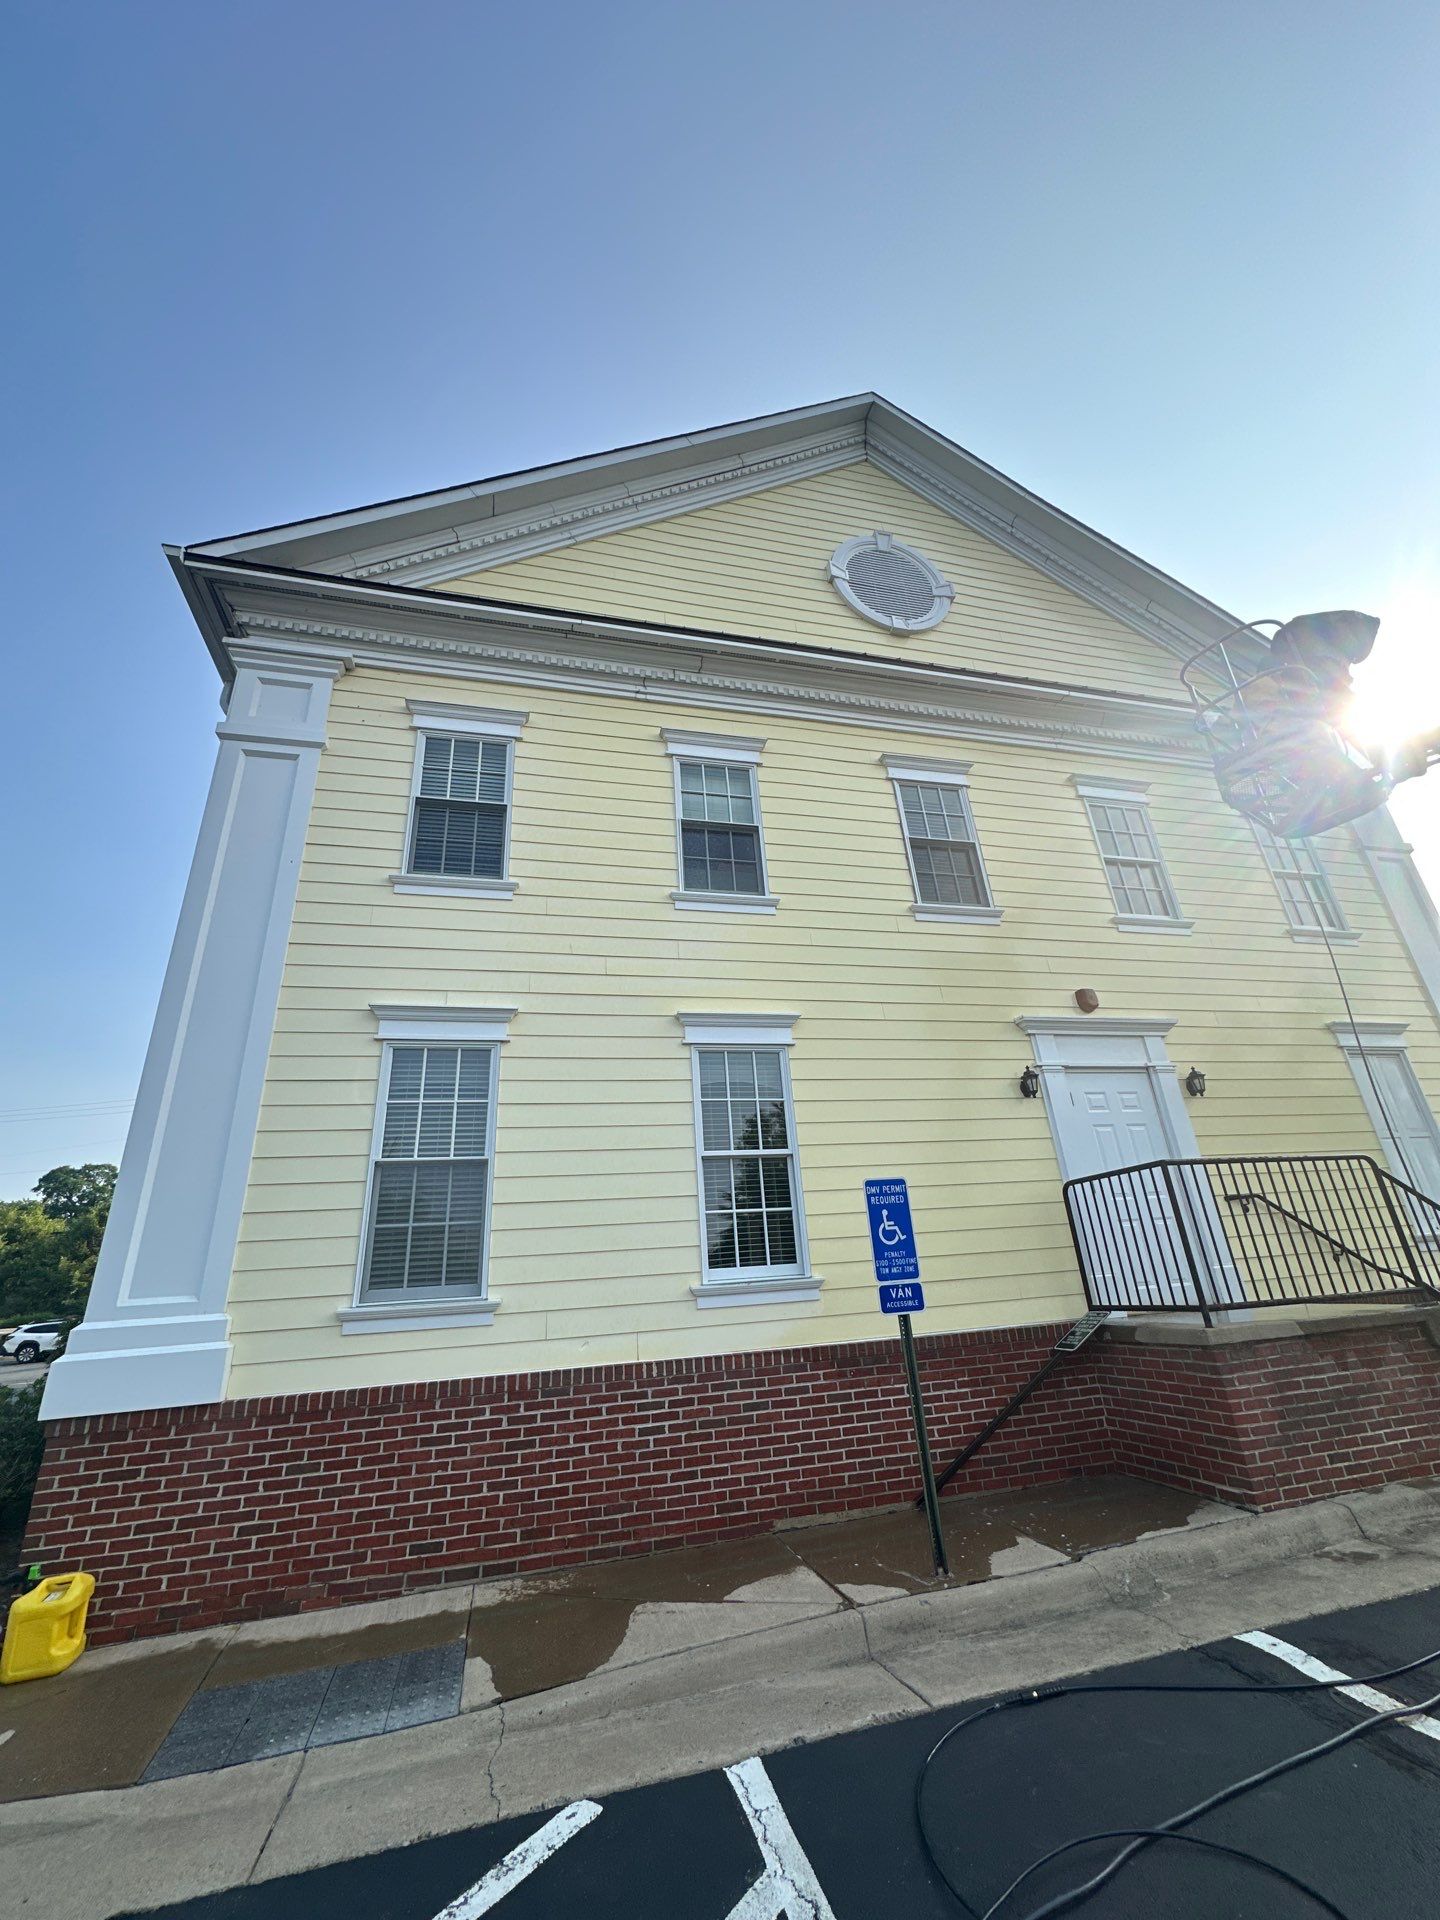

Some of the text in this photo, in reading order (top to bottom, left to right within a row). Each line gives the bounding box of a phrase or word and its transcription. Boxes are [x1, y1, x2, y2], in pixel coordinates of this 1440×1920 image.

[866, 1184, 906, 1194] DMV PERMIT
[870, 1195, 904, 1204] REQUIRED
[884, 1250, 906, 1258] PENALTY
[889, 1287, 912, 1298] VAN
[887, 1300, 918, 1308] ACCESSIBLE
